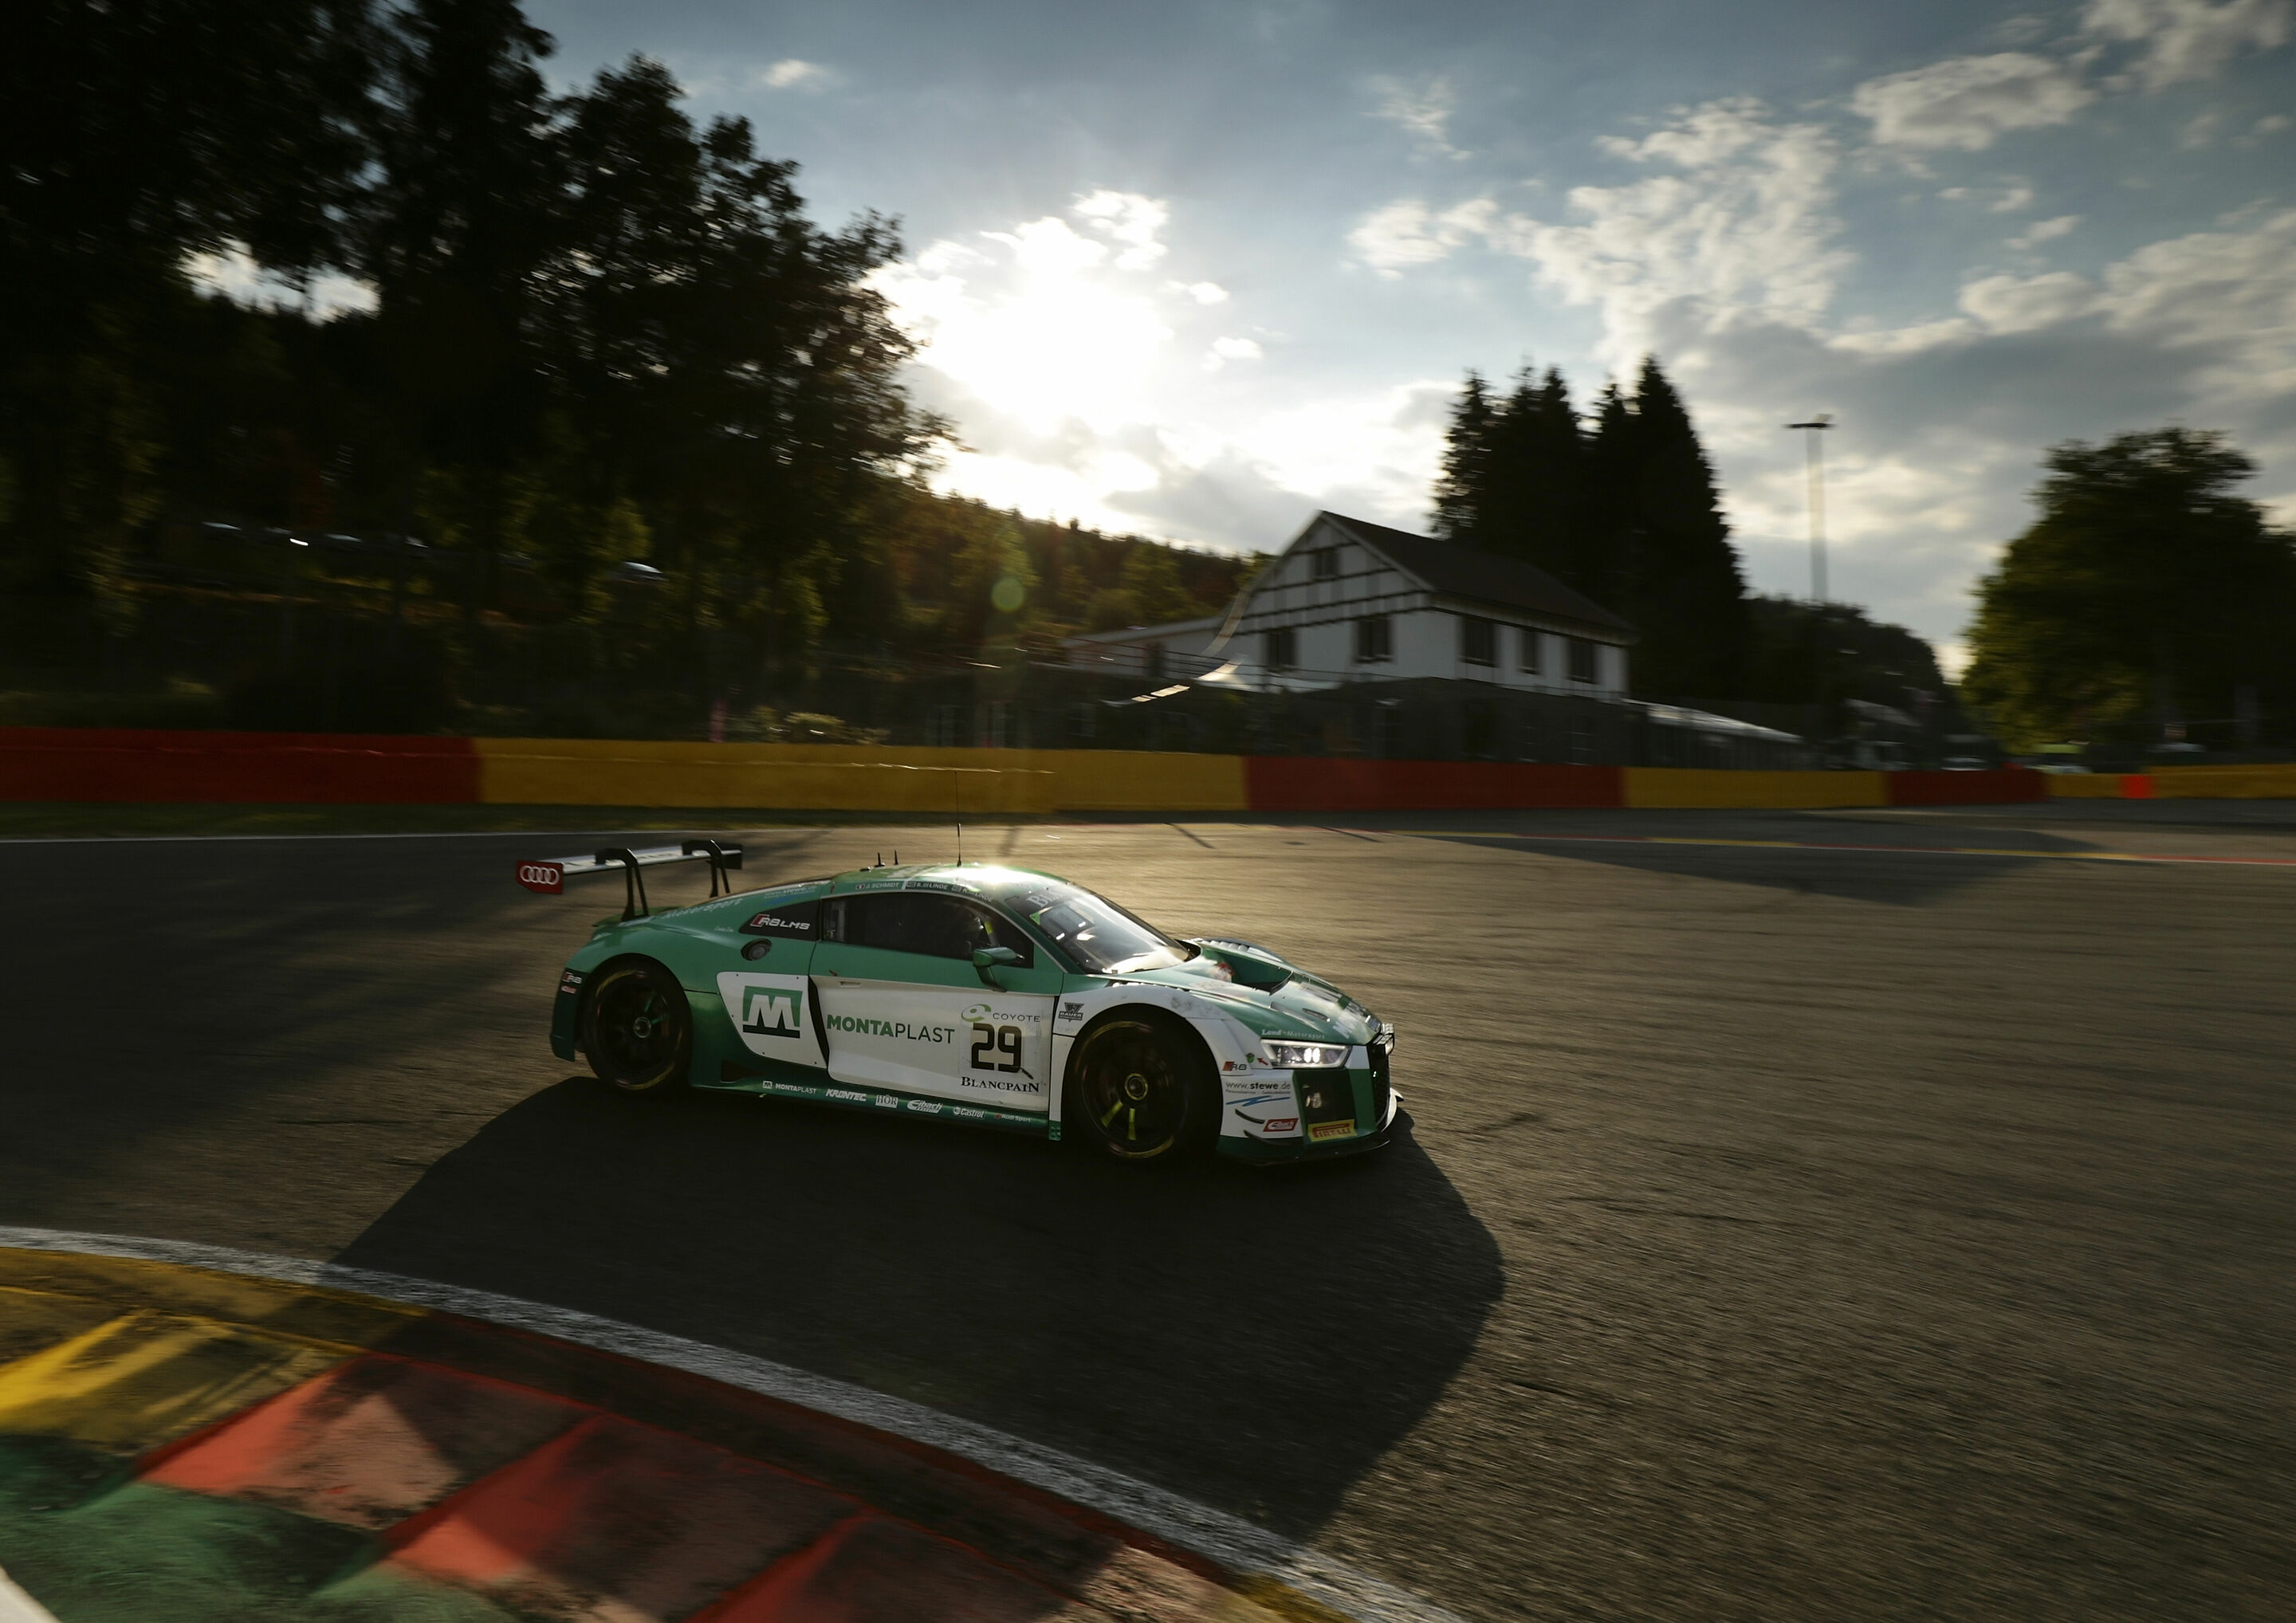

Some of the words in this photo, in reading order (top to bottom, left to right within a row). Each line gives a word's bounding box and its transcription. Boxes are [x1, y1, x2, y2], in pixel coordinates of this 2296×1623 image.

[993, 1012, 1040, 1023] COYOTE
[826, 1014, 955, 1044] MONTAPLAST
[971, 1022, 1022, 1073] 29
[776, 1083, 816, 1094] MONTAPLAST
[961, 1076, 1040, 1093] BLANCPAIN
[907, 1100, 943, 1114] Eibach
[960, 1107, 985, 1118] Castrol
[1311, 1122, 1351, 1138] PIRELLI
